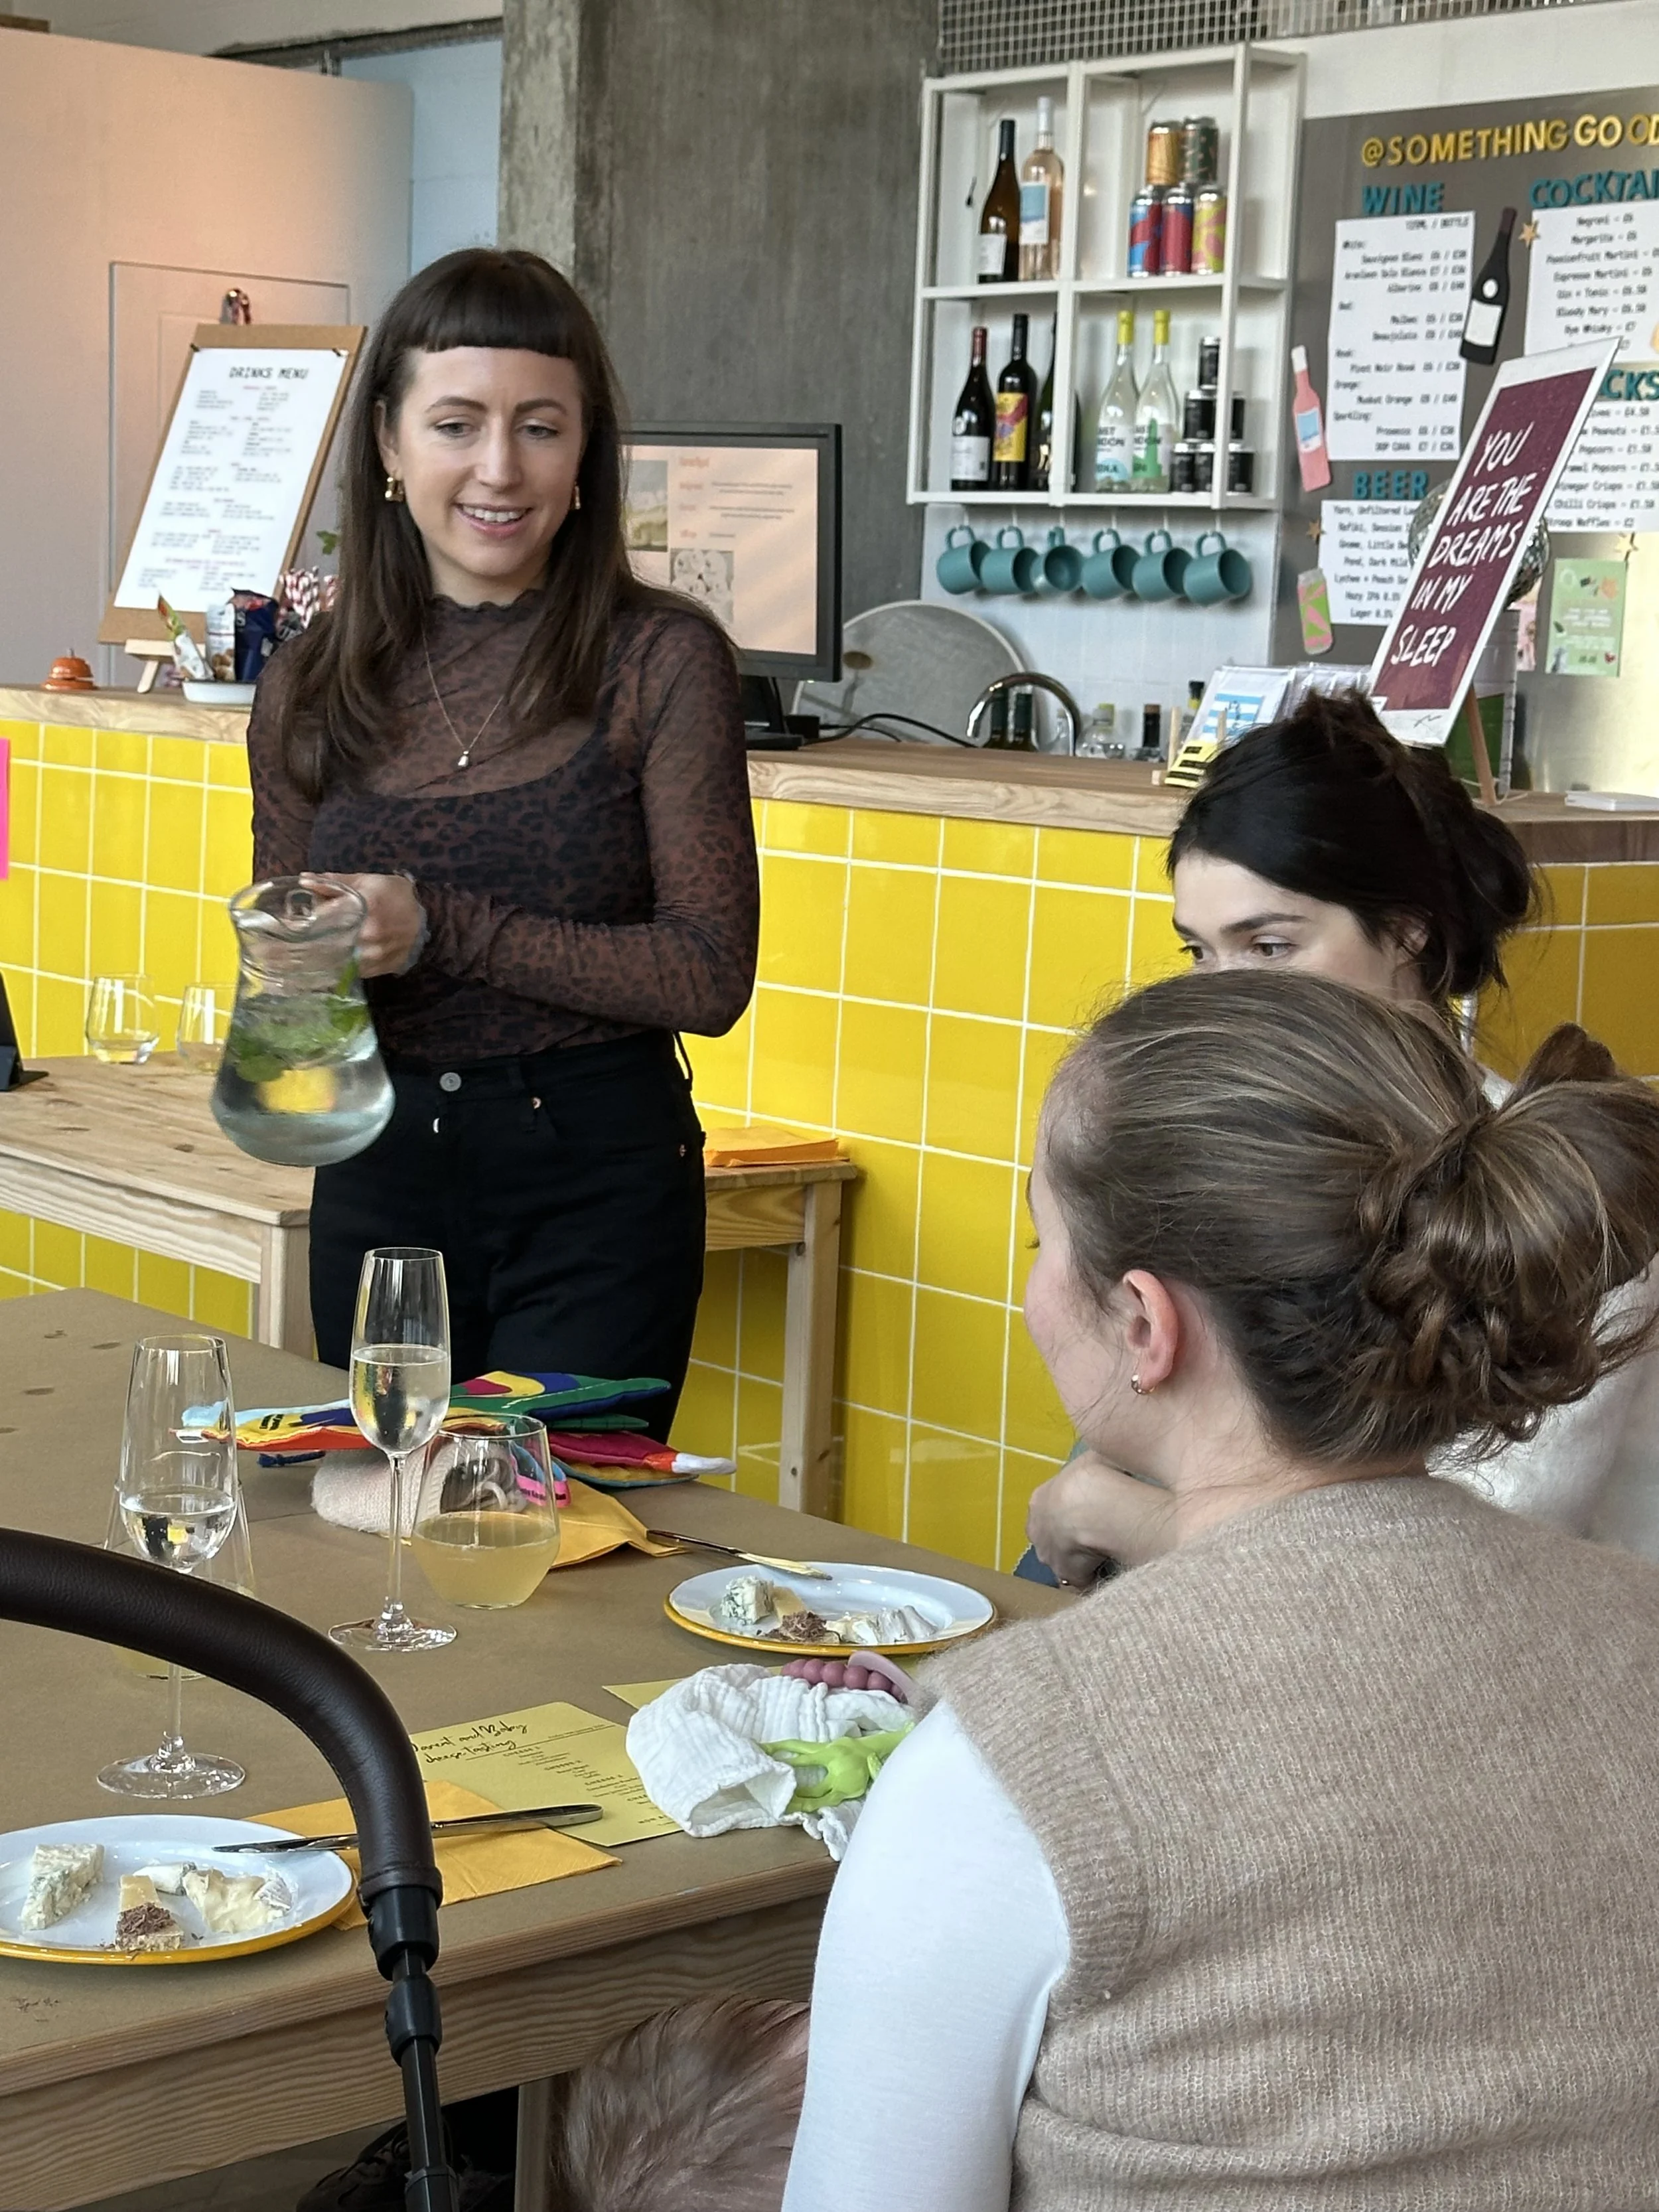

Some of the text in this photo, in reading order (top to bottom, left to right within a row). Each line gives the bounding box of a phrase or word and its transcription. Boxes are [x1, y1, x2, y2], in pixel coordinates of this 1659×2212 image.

[1361, 119, 1569, 167] @SOMETHING
[1362, 181, 1445, 214] WINE
[229, 367, 309, 380] DRINKS MENU
[1598, 368, 1659, 401] CKS
[1474, 421, 1535, 477] YOU
[1352, 471, 1429, 500] BEER
[1446, 473, 1538, 527] ARE THE
[1427, 520, 1523, 568] DREAMS
[1411, 573, 1474, 615] IN MY
[1391, 624, 1457, 667] SLEEP
[459, 1727, 484, 1743] and
[478, 1720, 527, 1737] Baby
